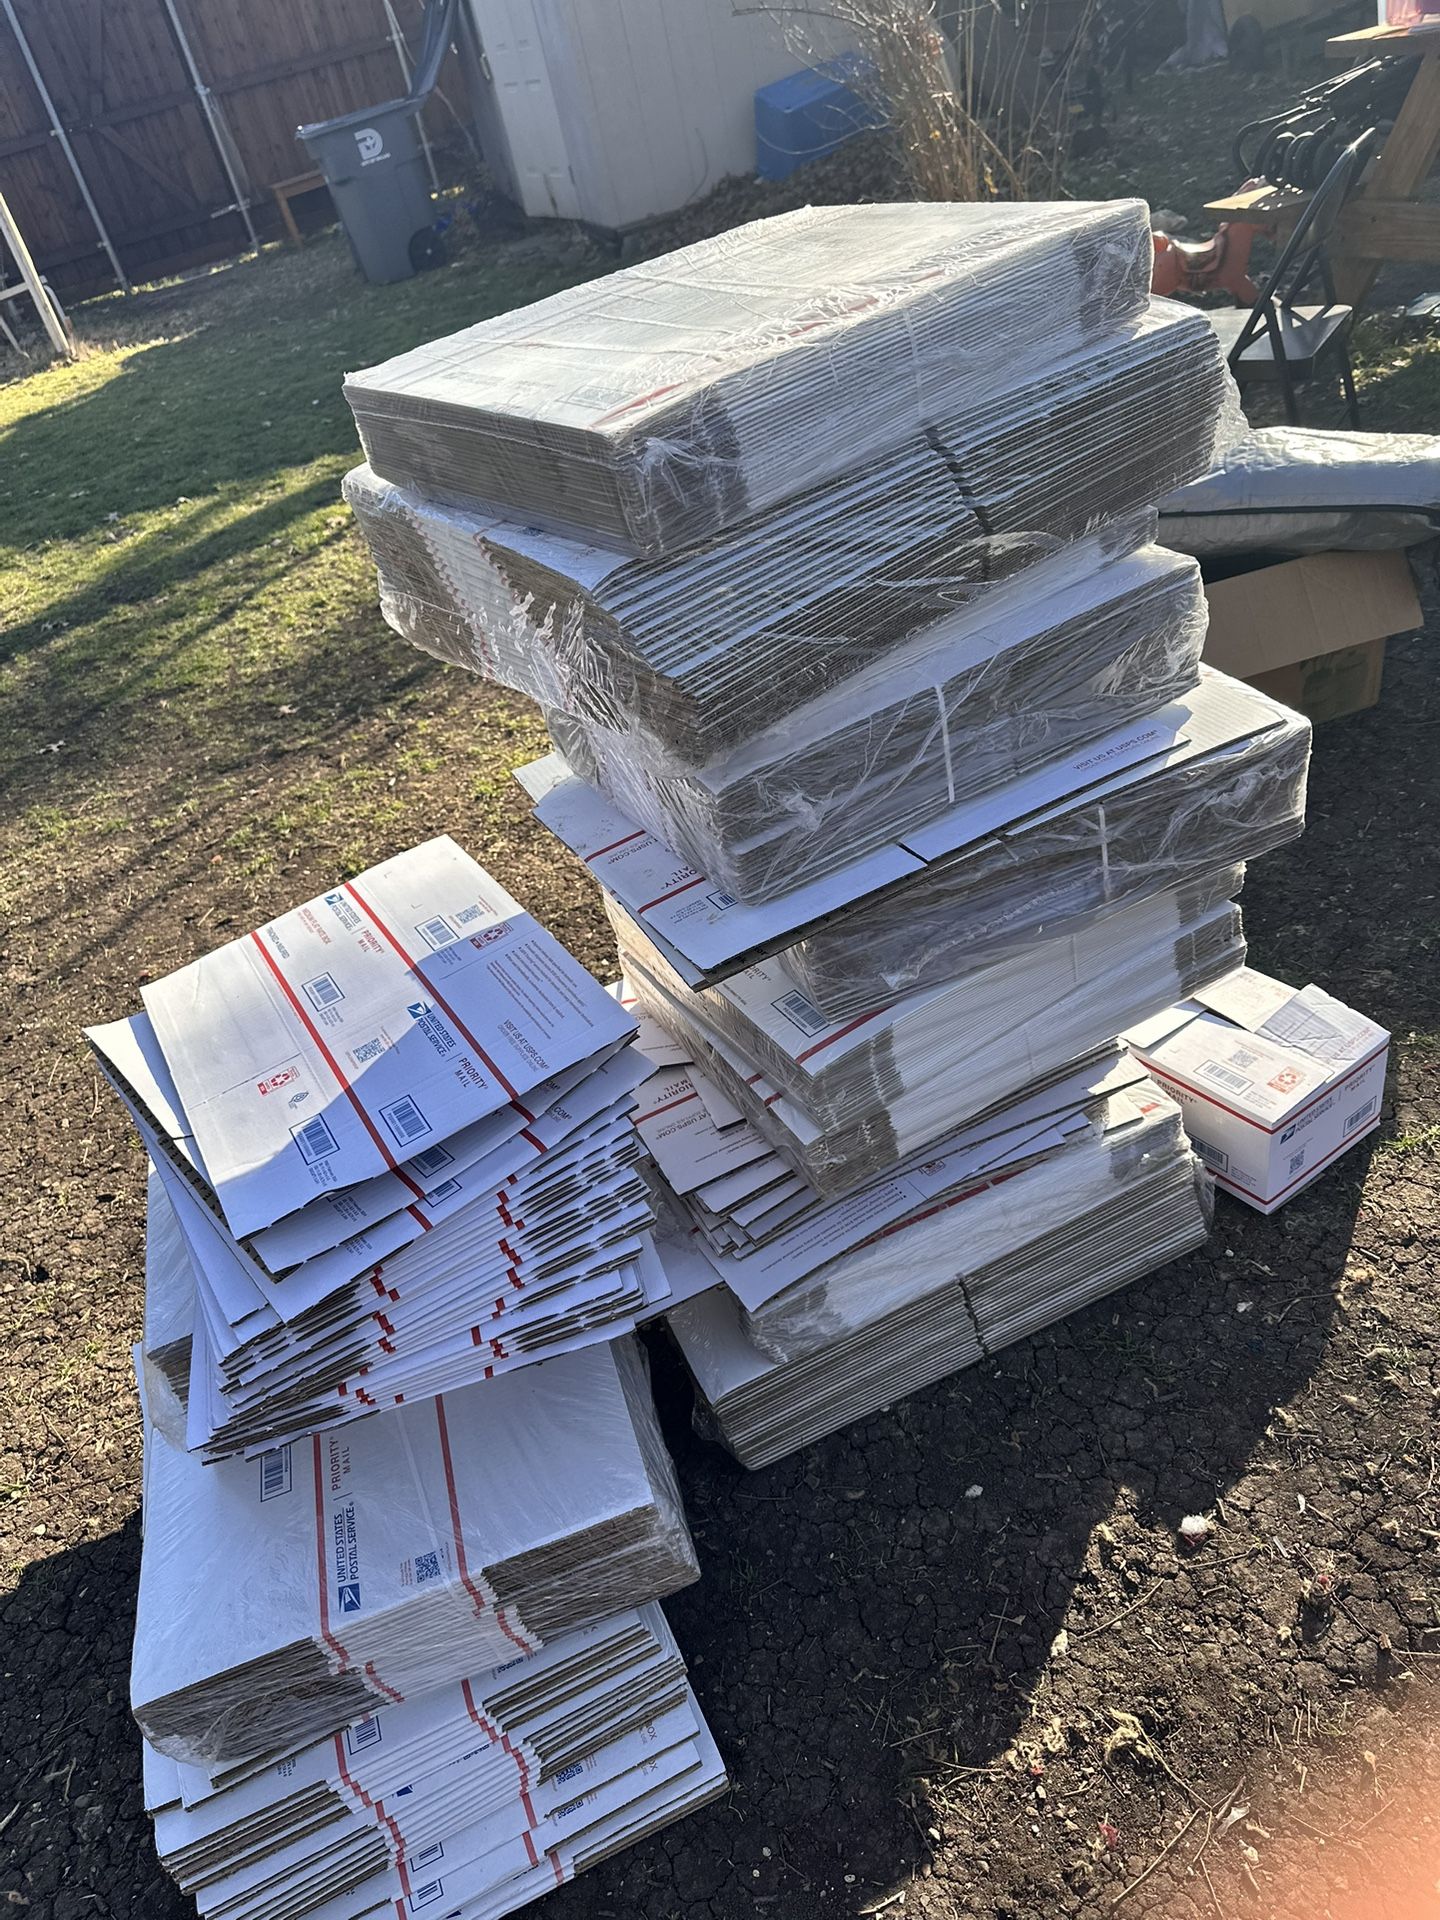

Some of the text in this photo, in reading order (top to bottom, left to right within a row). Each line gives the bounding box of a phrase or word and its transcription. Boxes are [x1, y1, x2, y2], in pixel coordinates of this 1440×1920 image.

[1073, 759, 1093, 770] VISIT
[357, 939, 369, 953] MAIL
[416, 1017, 433, 1036] POSTAL
[427, 1013, 457, 1048] UNITED STATES
[503, 1018, 518, 1033] VISIT
[454, 1069, 472, 1088] MAIL
[664, 1079, 688, 1093] MAIL
[653, 1083, 694, 1105] IORITY®
[341, 1446, 351, 1474] MAIL
[334, 1513, 347, 1583] UNITED STATES
[348, 1544, 359, 1580] POSTAL
